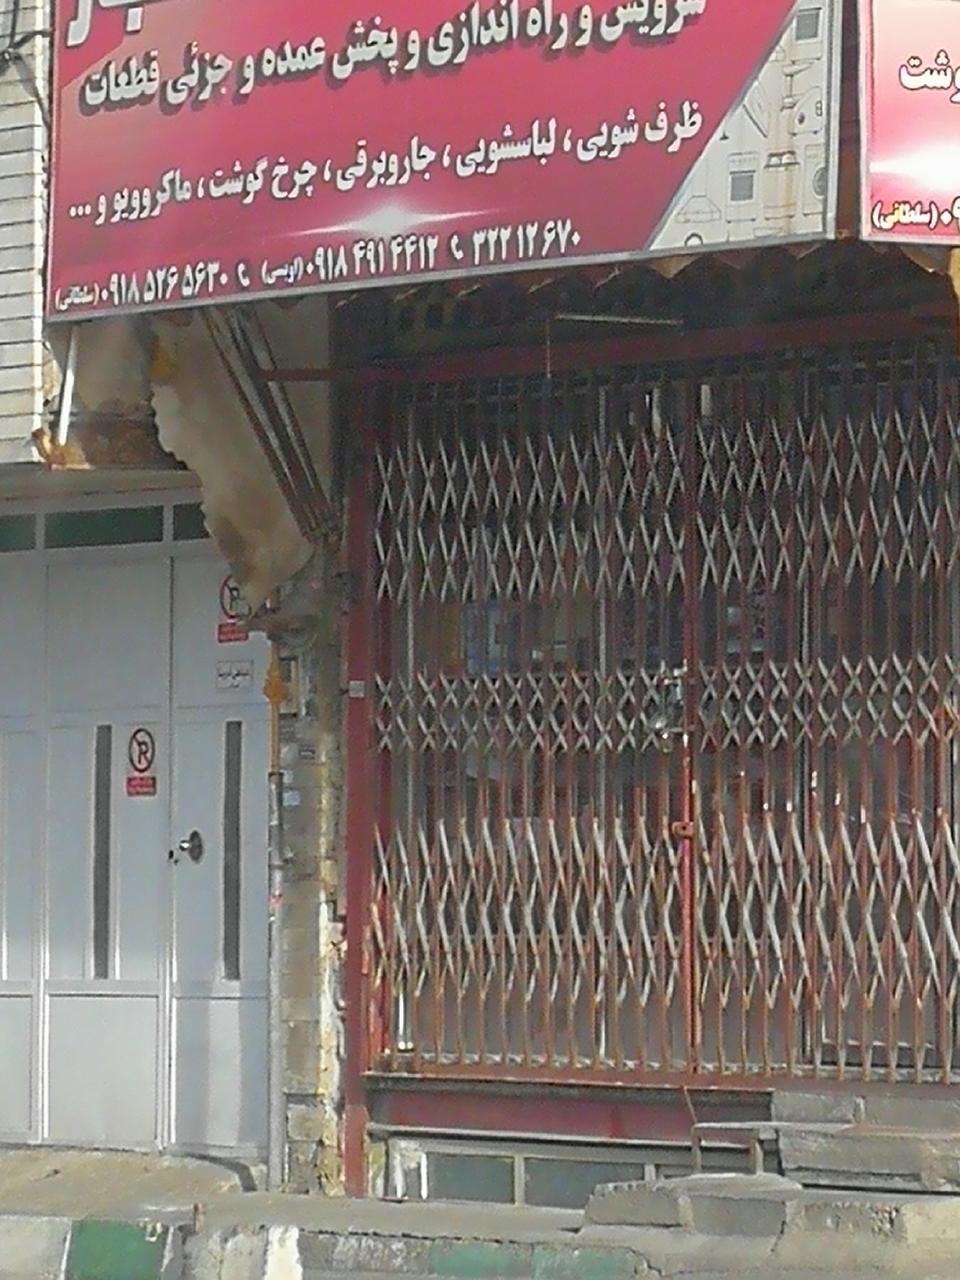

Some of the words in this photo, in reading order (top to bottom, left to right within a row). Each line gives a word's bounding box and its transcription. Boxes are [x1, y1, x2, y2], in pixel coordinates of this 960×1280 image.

[575, 4, 593, 47] و
[261, 35, 326, 77] عمده
[332, 16, 398, 79] پخش
[404, 29, 421, 70] و
[85, 49, 161, 107] قطعات
[165, 40, 233, 105] جزئی
[239, 54, 255, 95] و
[644, 100, 702, 152] ظرف
[110, 168, 192, 223] ماکروویو
[271, 156, 318, 199] چرخ
[95, 194, 107, 225] و
